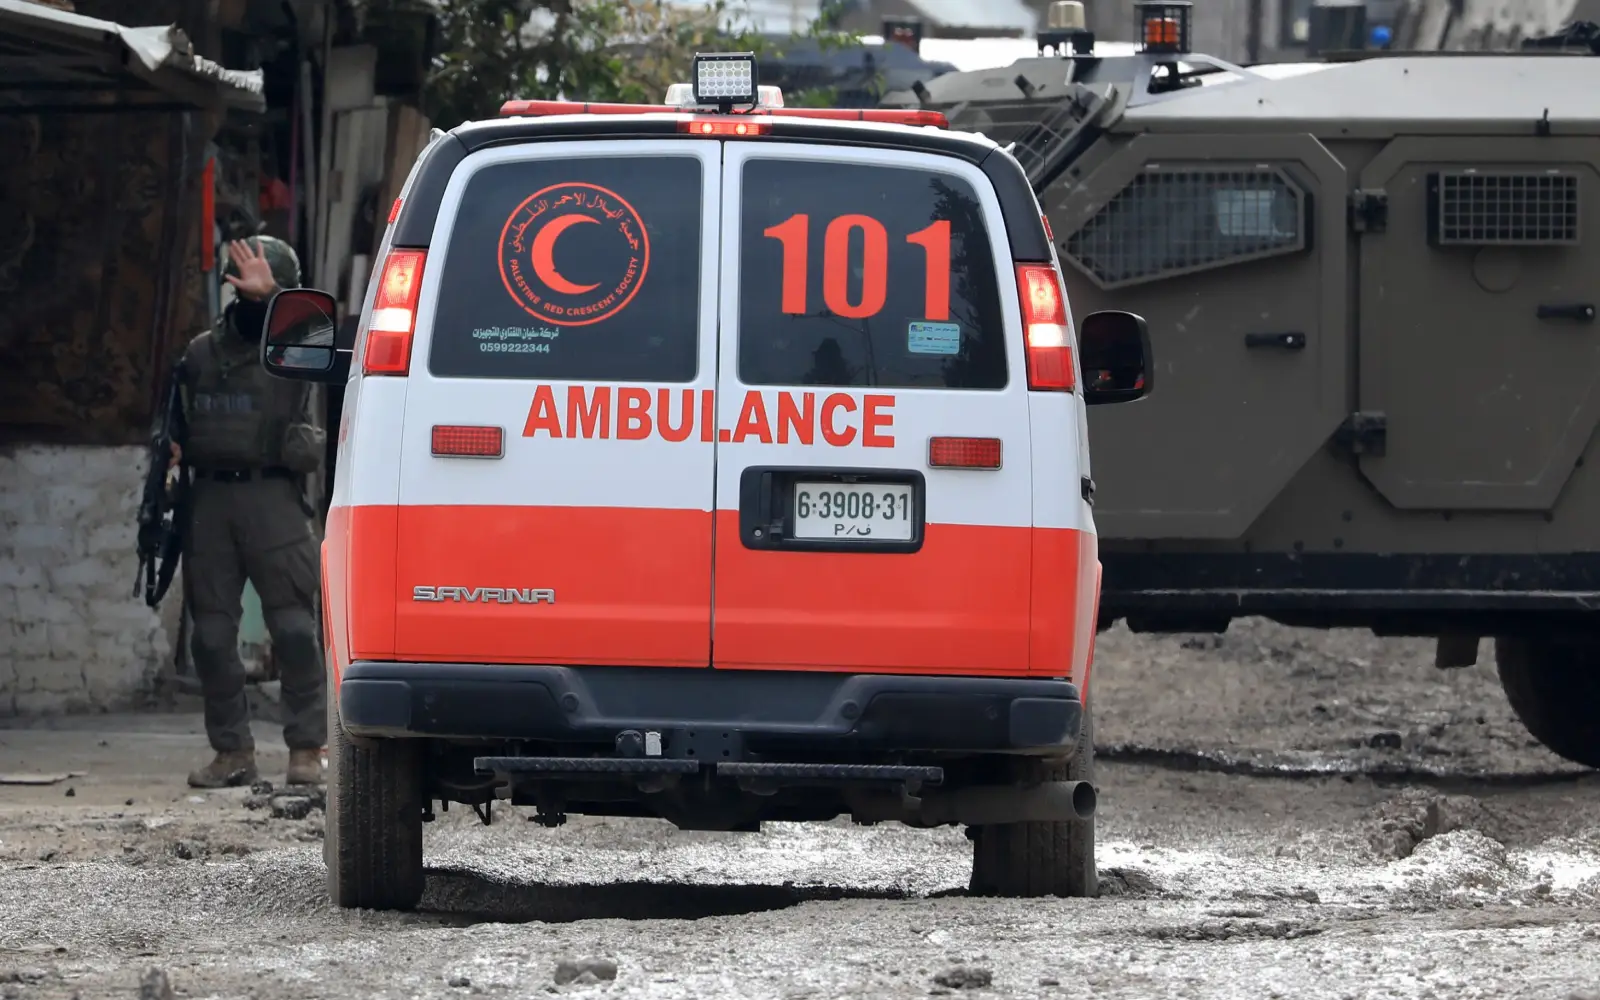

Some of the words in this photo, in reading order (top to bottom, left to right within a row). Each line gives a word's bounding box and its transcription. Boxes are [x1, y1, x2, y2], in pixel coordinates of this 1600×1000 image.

[586, 194, 624, 219] الهلال
[508, 199, 549, 253] الفلسطيني
[763, 213, 951, 321] 101
[509, 258, 542, 305] PALESTINE
[543, 302, 564, 316] RED
[566, 293, 616, 317] CRESCENT
[615, 256, 639, 296] SOCIETY
[522, 326, 539, 340] سفيان
[539, 326, 560, 340] شركة
[479, 342, 550, 354] 0599222344
[521, 384, 896, 449] AMBULANCE
[412, 585, 555, 604] SAVANA
